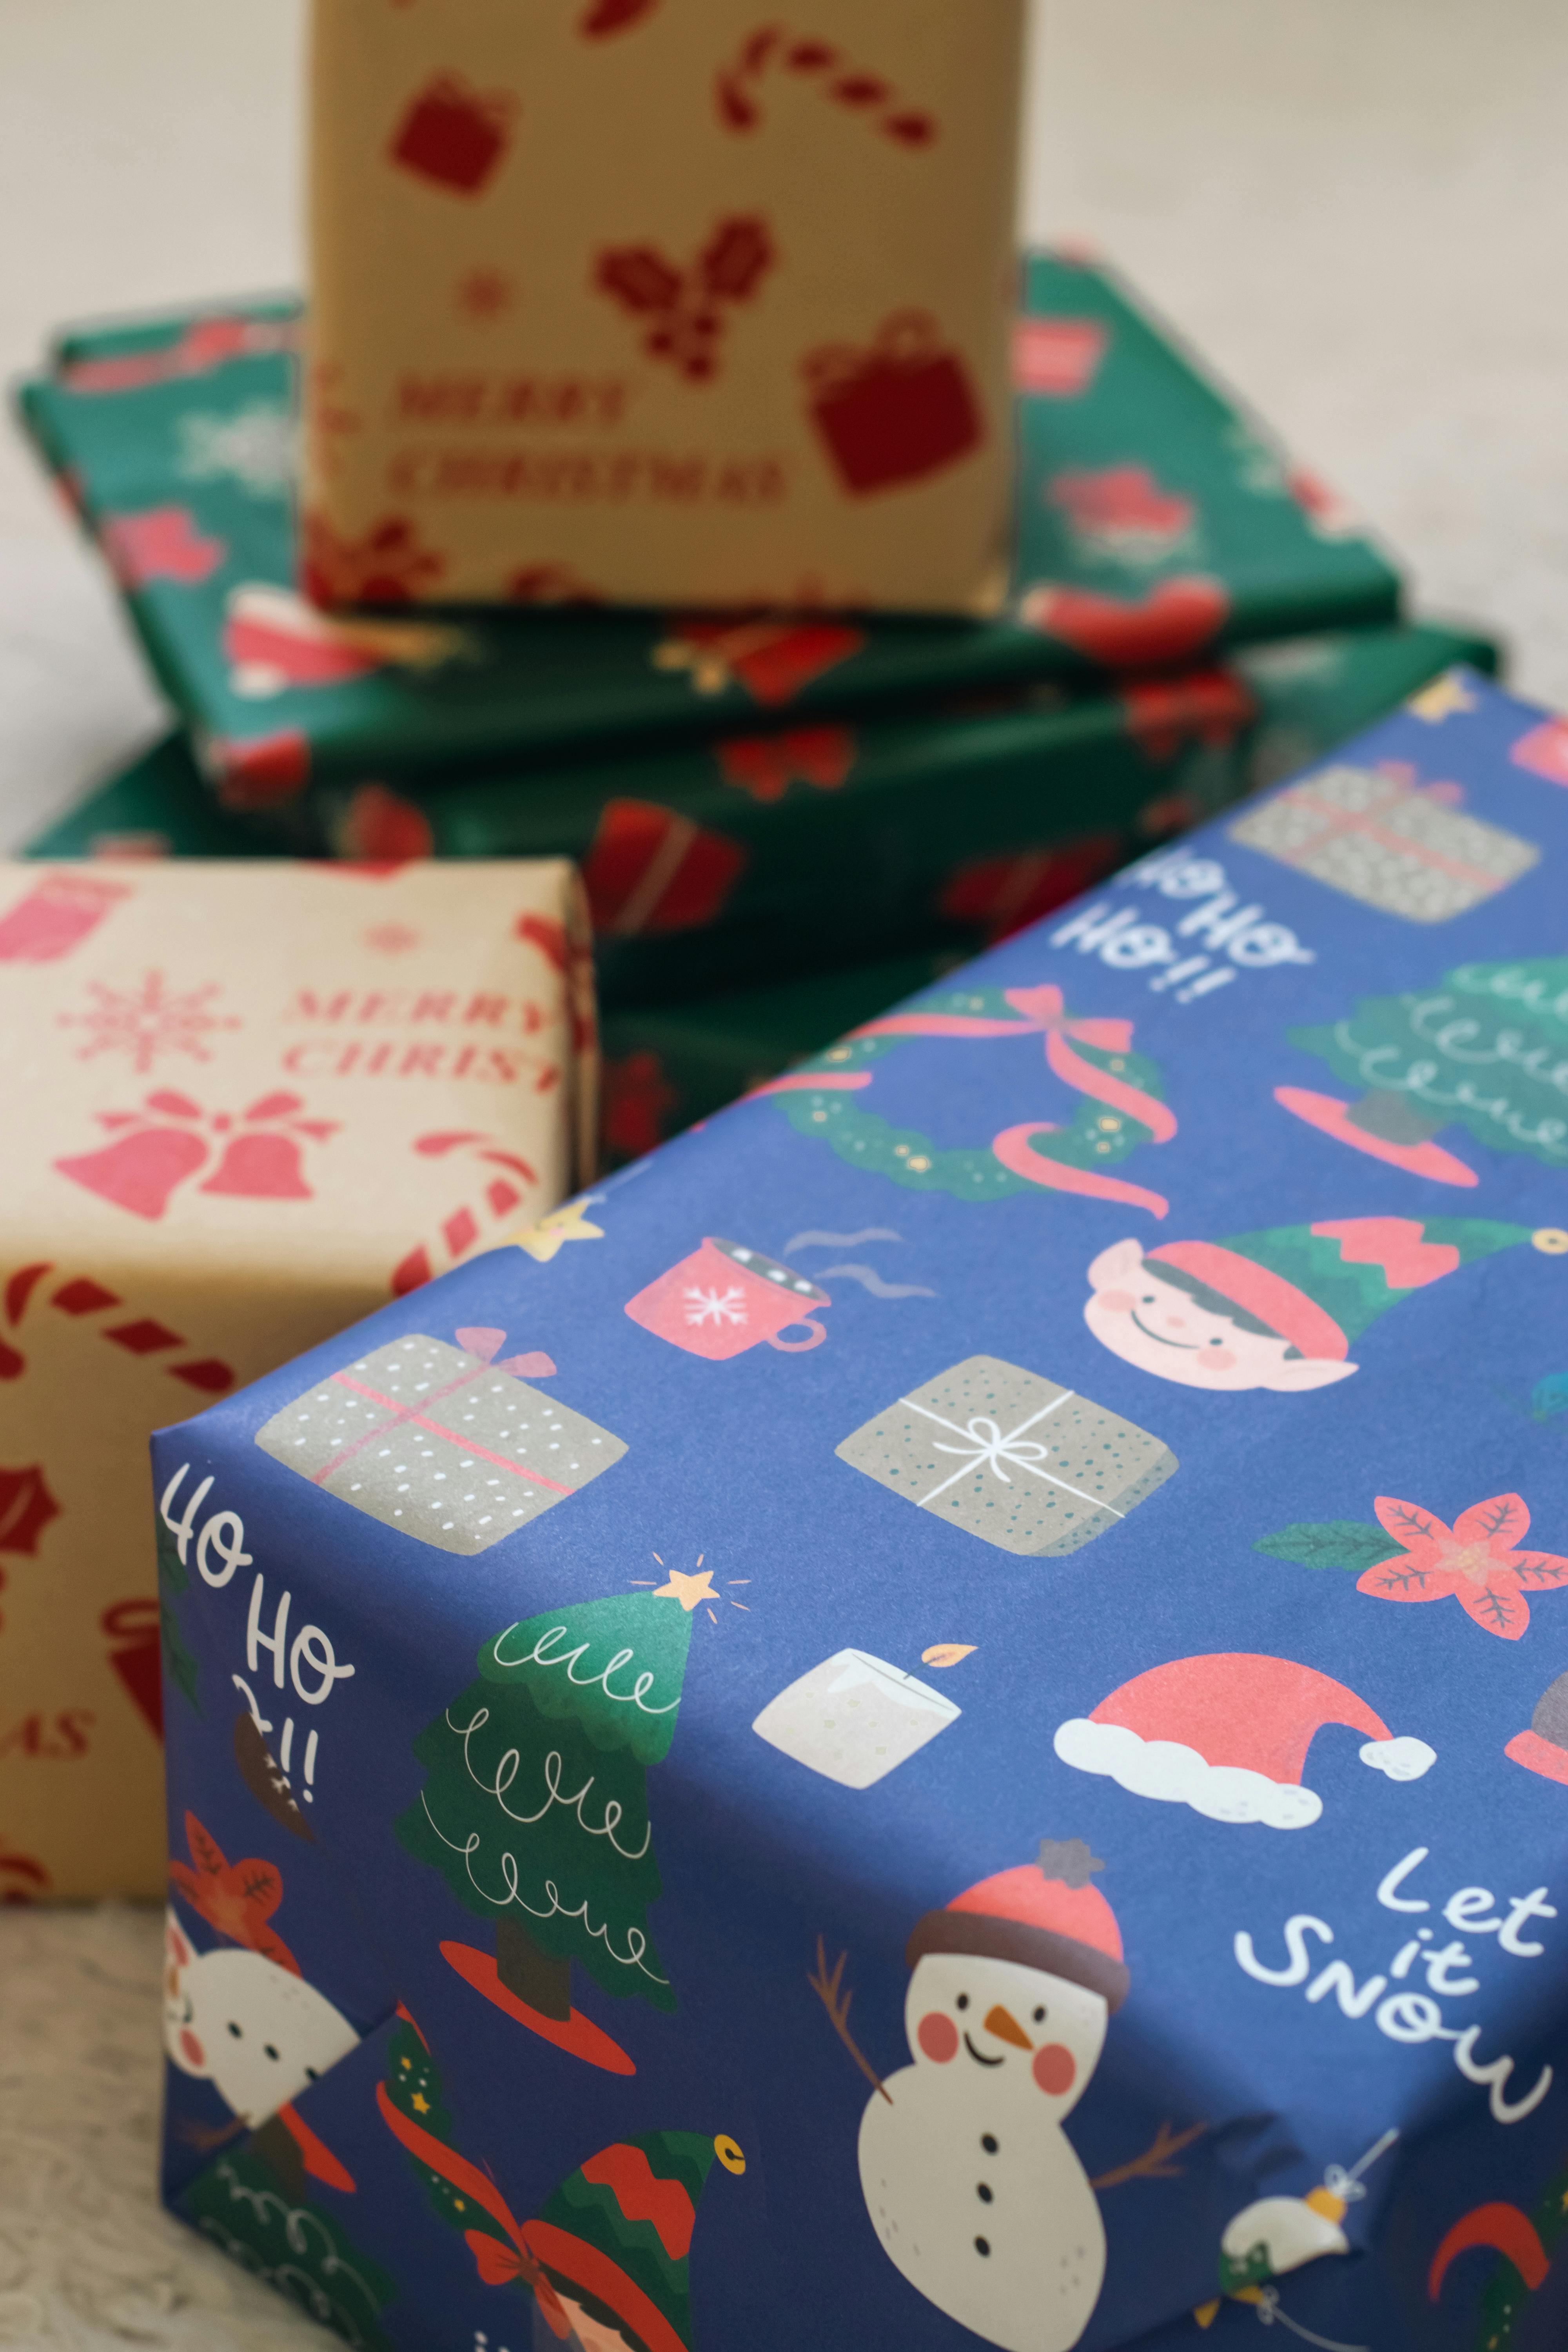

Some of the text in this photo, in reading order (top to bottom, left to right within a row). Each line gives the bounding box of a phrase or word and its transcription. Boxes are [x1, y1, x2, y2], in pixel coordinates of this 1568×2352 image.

[394, 370, 632, 427] MERRY
[386, 449, 794, 509] CHRISTMAS
[283, 987, 559, 1035] MERRY
[1377, 1846, 1558, 1957] Let
[1390, 1928, 1480, 1996] it
